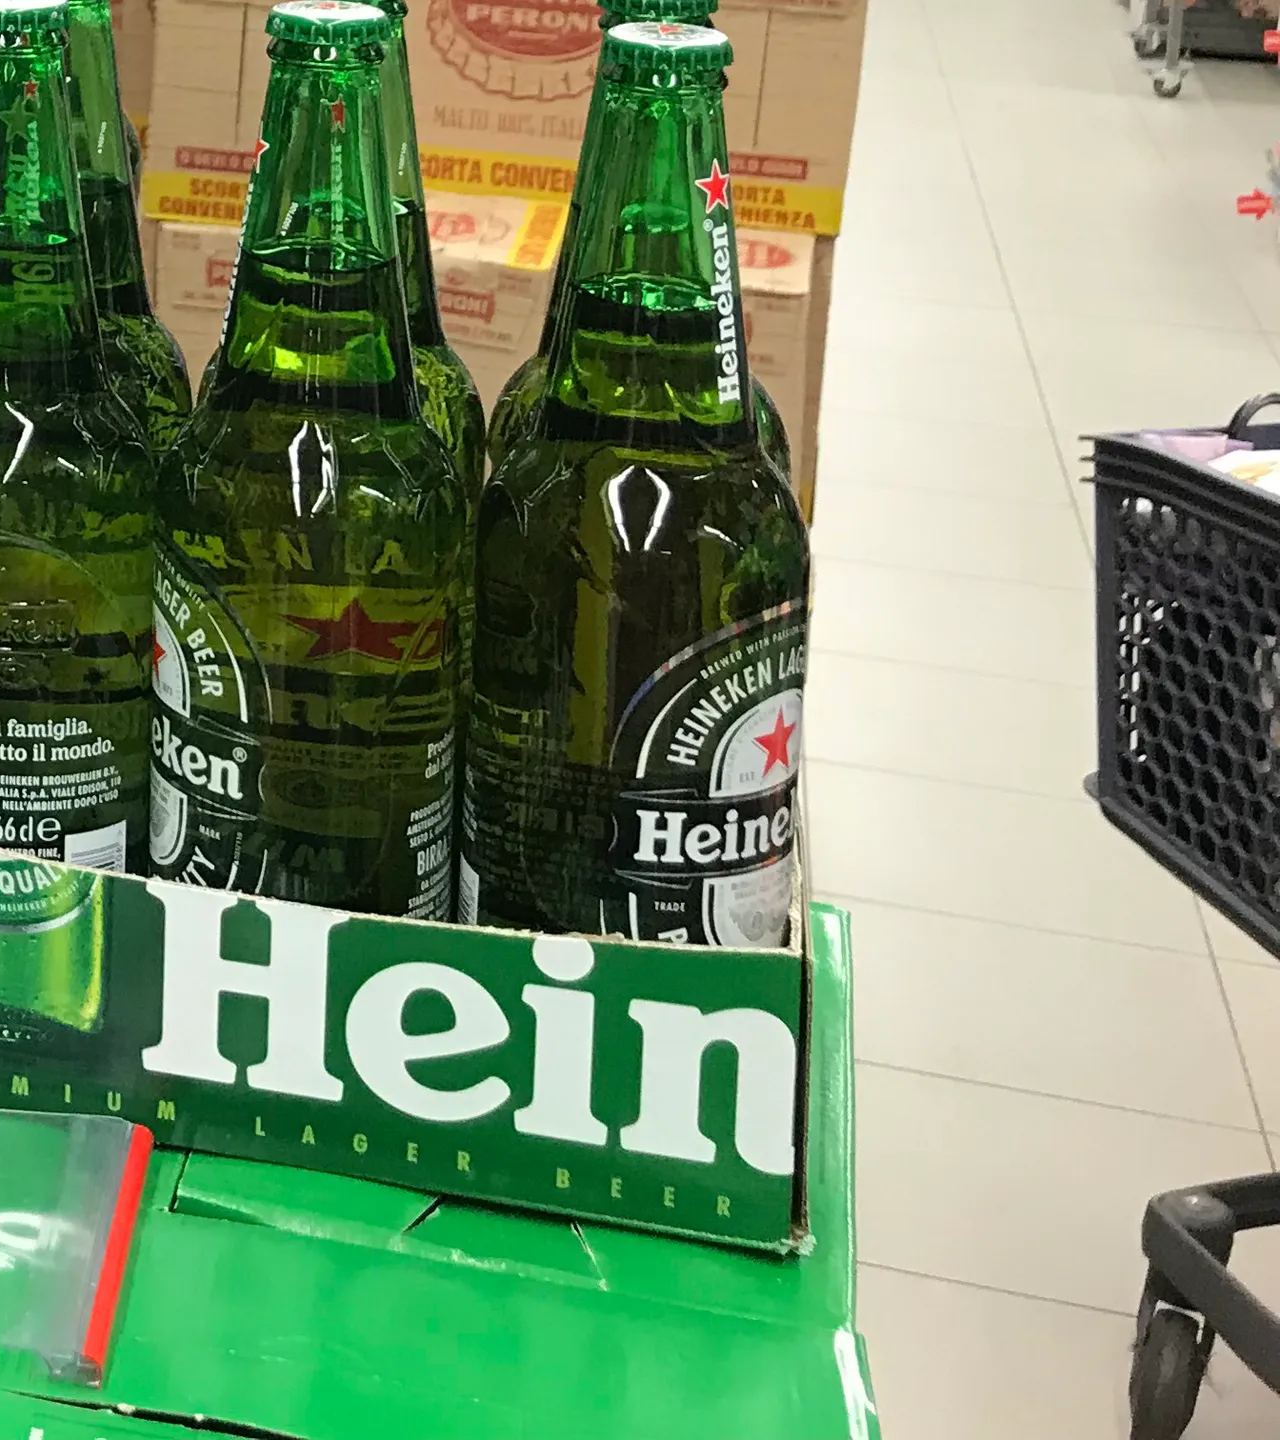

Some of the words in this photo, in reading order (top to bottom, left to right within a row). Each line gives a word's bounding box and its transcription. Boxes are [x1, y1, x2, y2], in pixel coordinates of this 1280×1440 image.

[719, 221, 741, 406] Heineken
[186, 626, 224, 699] BEER
[700, 650, 742, 680] BREWED
[744, 636, 770, 658] WITH
[666, 656, 774, 768] HEINEKEN
[6, 718, 93, 741] famiglia.
[32, 742, 46, 762] il
[50, 737, 116, 761] mondo.
[42, 770, 102, 786] BROUWERIJEN
[51, 785, 76, 799] VIALE
[2, 799, 72, 812] NELL'AMBIENTE
[73, 794, 98, 810] DOPO
[653, 899, 686, 914] TRADE
[141, 879, 797, 1178] Hein
[254, 1116, 474, 1174] LAGER
[555, 1168, 733, 1219] BEER
